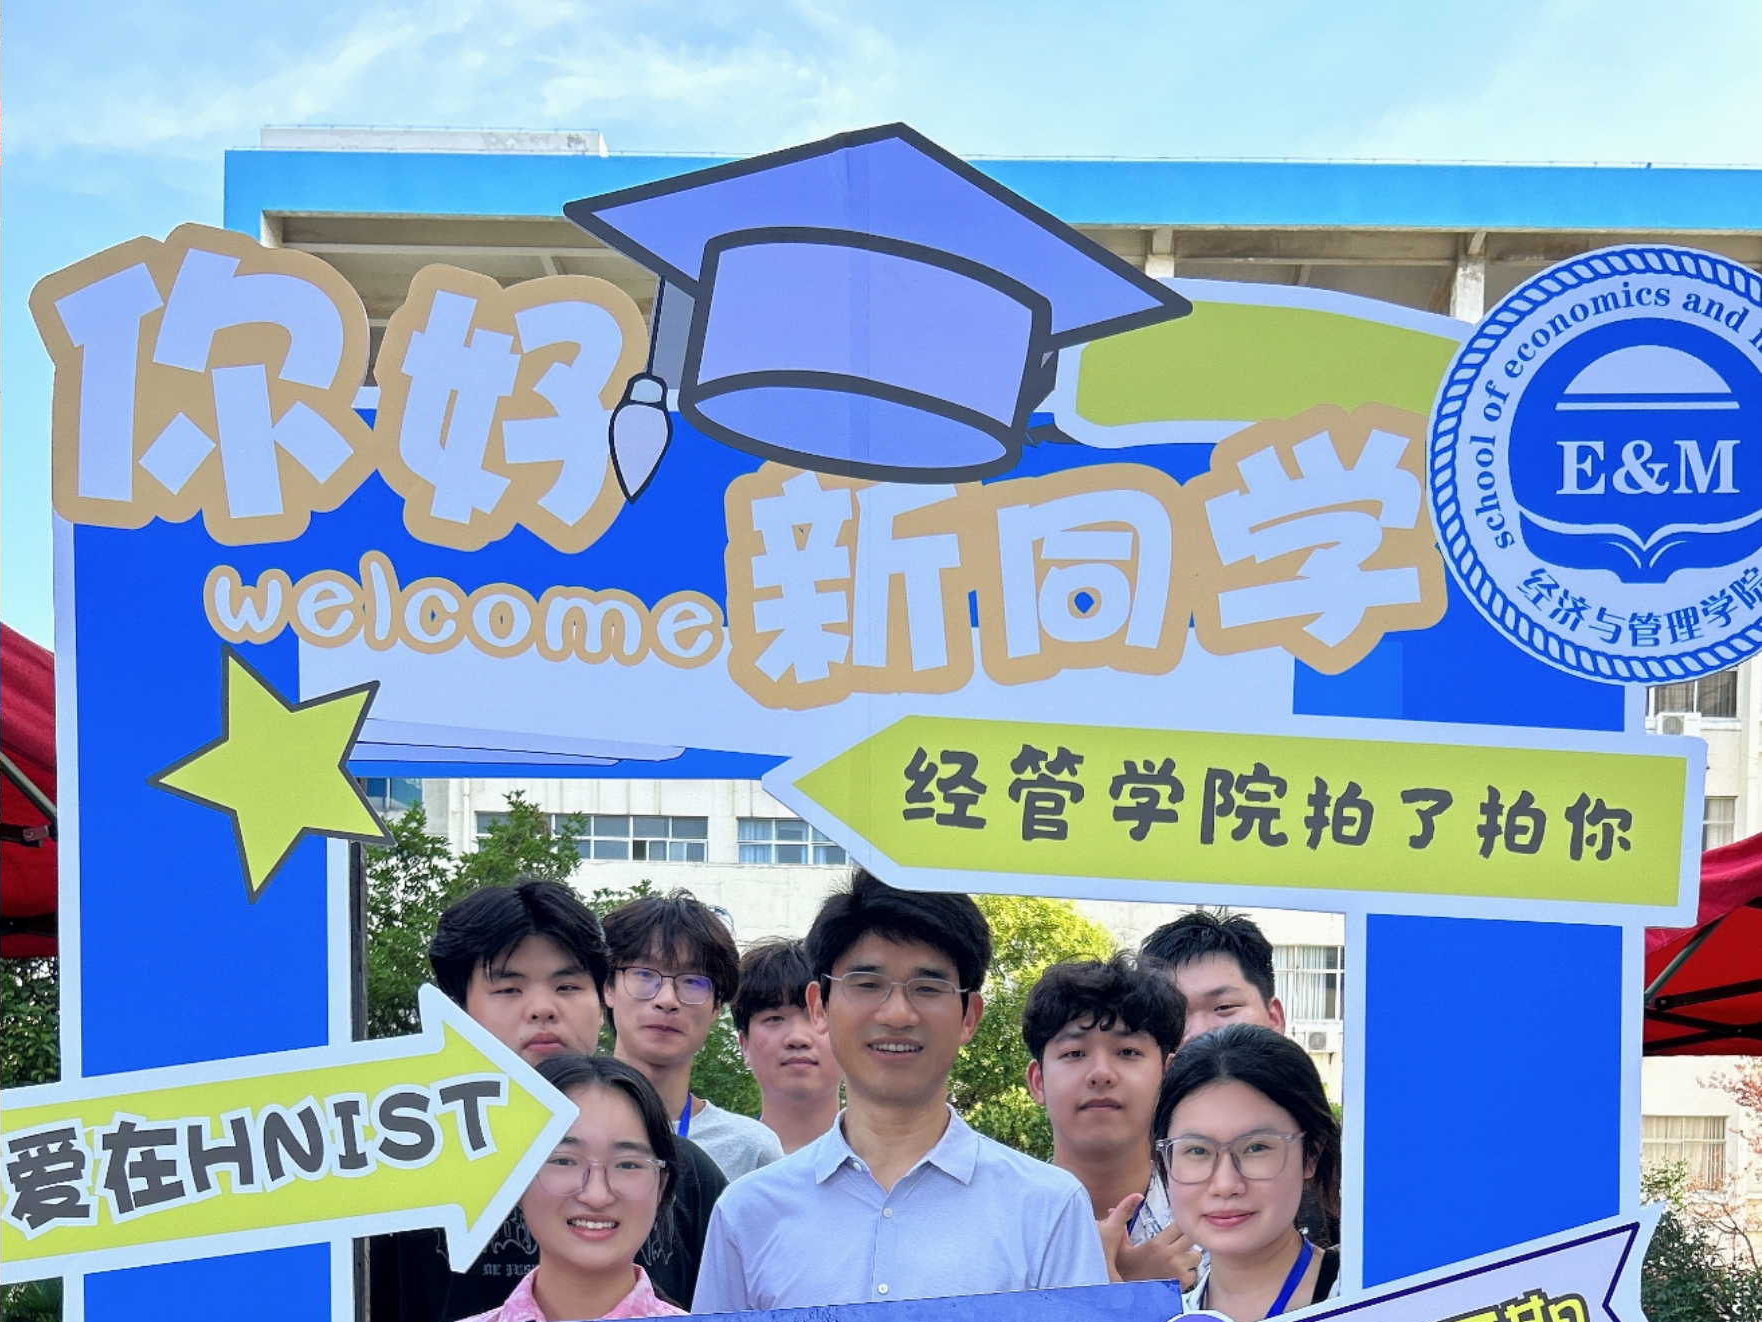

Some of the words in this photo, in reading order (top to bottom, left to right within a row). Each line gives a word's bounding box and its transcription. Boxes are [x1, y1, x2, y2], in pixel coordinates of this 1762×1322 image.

[1503, 281, 1671, 381] economics
[1682, 293, 1750, 333] and
[53, 248, 624, 527] 你好
[1482, 379, 1511, 420] of
[1469, 434, 1517, 551] school
[1555, 439, 1741, 496] E&M
[212, 559, 716, 660] welcome
[751, 428, 1422, 683] 新同学
[902, 743, 1634, 862] 经管学院拍了拍你
[6, 1079, 502, 1230] 爱在HNIST
